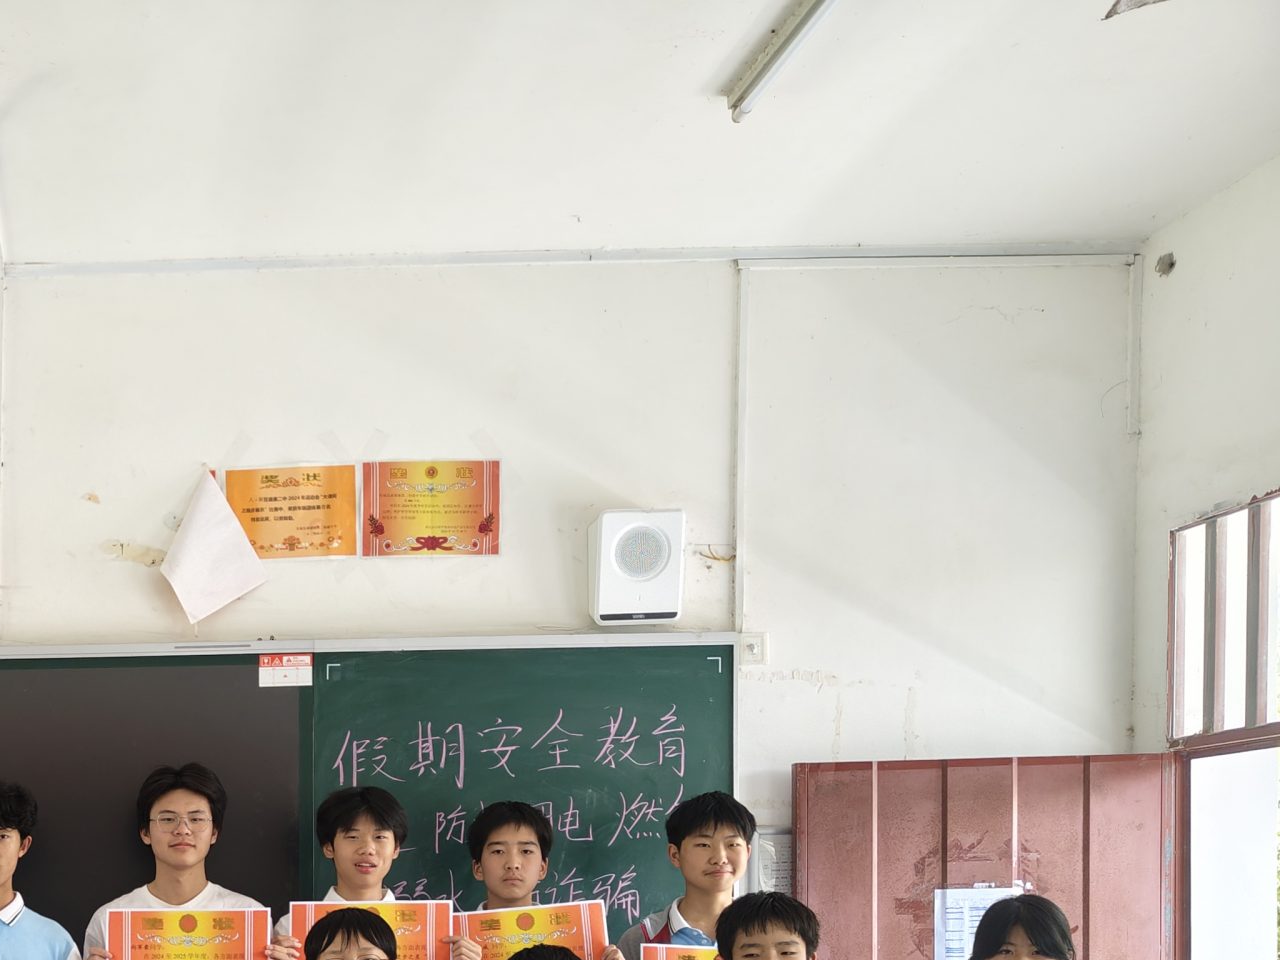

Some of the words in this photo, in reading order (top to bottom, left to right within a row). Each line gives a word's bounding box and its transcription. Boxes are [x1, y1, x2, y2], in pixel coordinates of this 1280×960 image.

[332, 704, 687, 790] 假期安全教育
